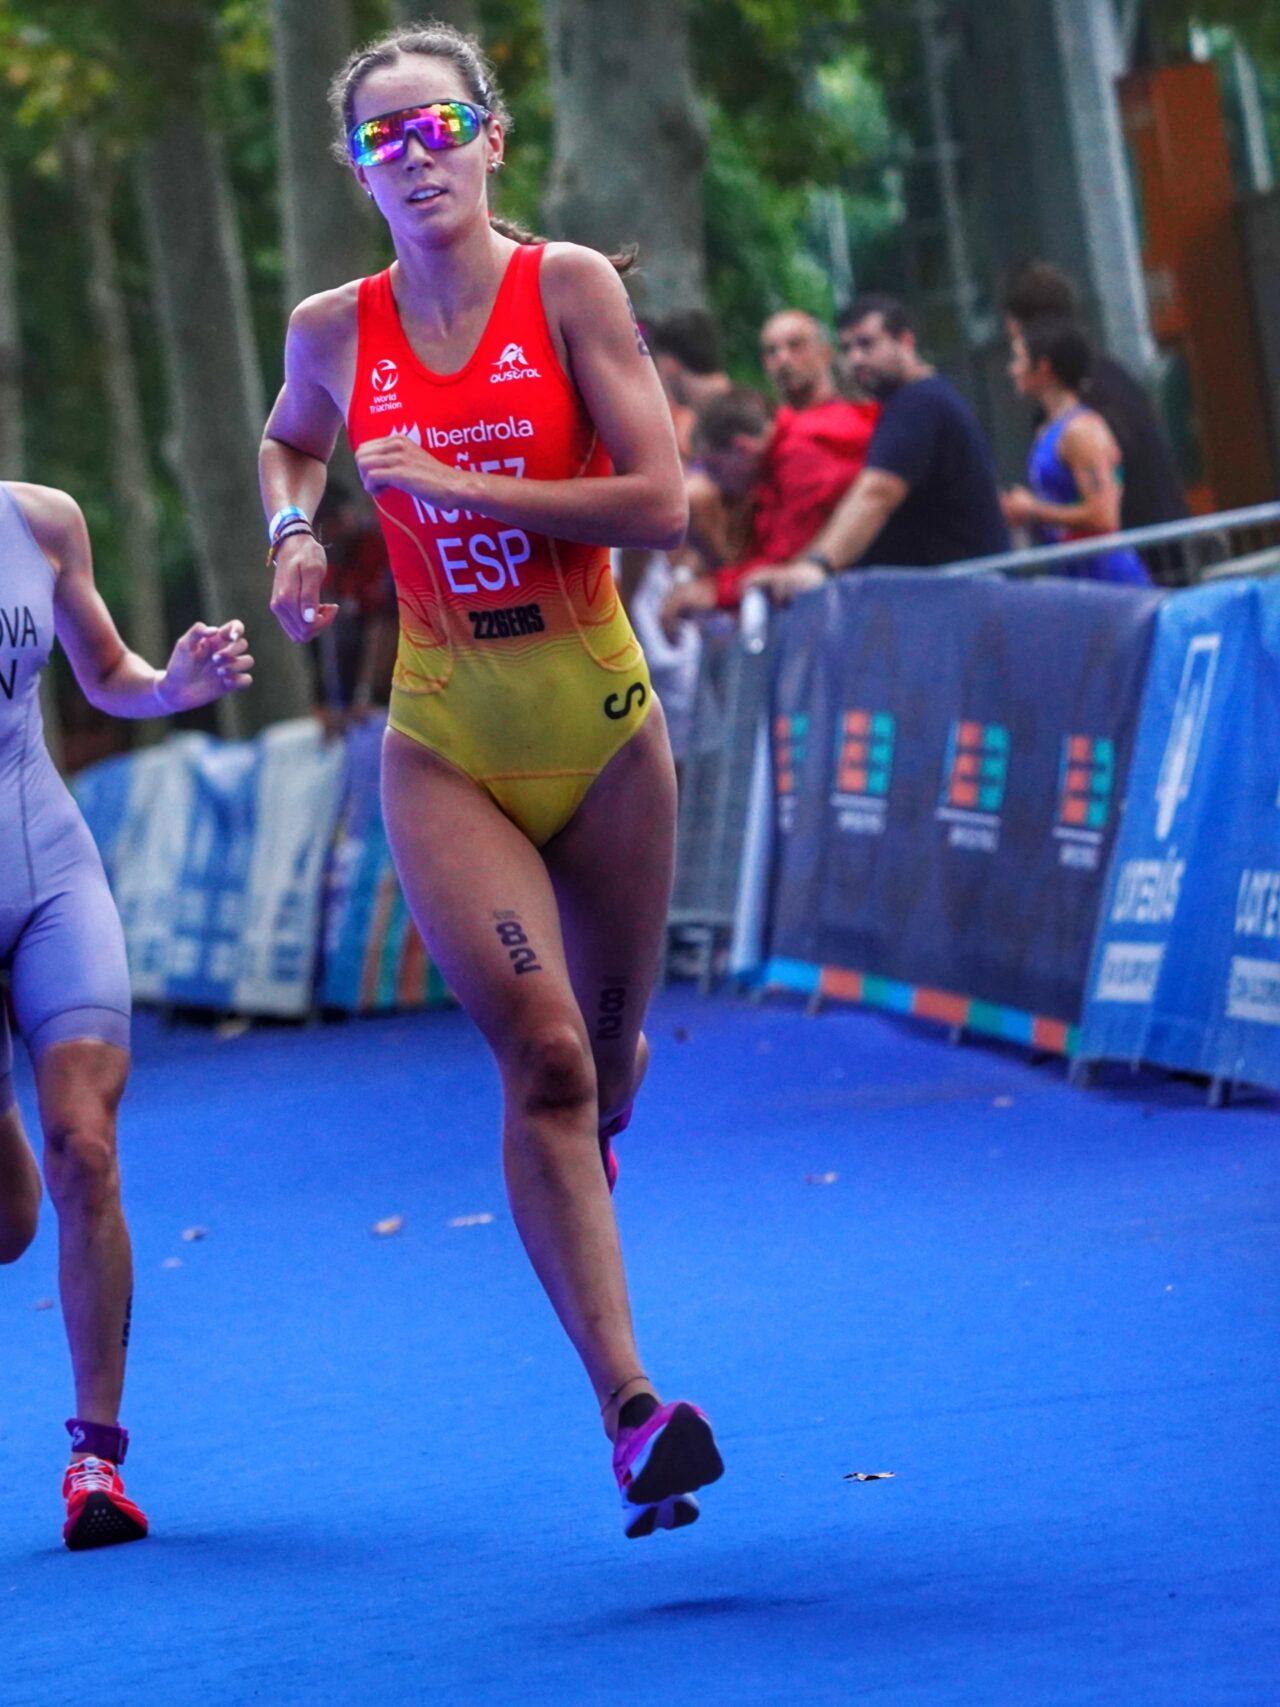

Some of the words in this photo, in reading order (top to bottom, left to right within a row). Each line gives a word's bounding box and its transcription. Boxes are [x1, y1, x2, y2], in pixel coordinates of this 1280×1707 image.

[489, 368, 543, 383] austral
[368, 400, 403, 415] Triathlon
[372, 392, 398, 404] World
[426, 415, 534, 448] Iberdrola
[436, 528, 532, 594] ESP
[467, 602, 546, 640] 226ERS
[495, 921, 542, 975] 82
